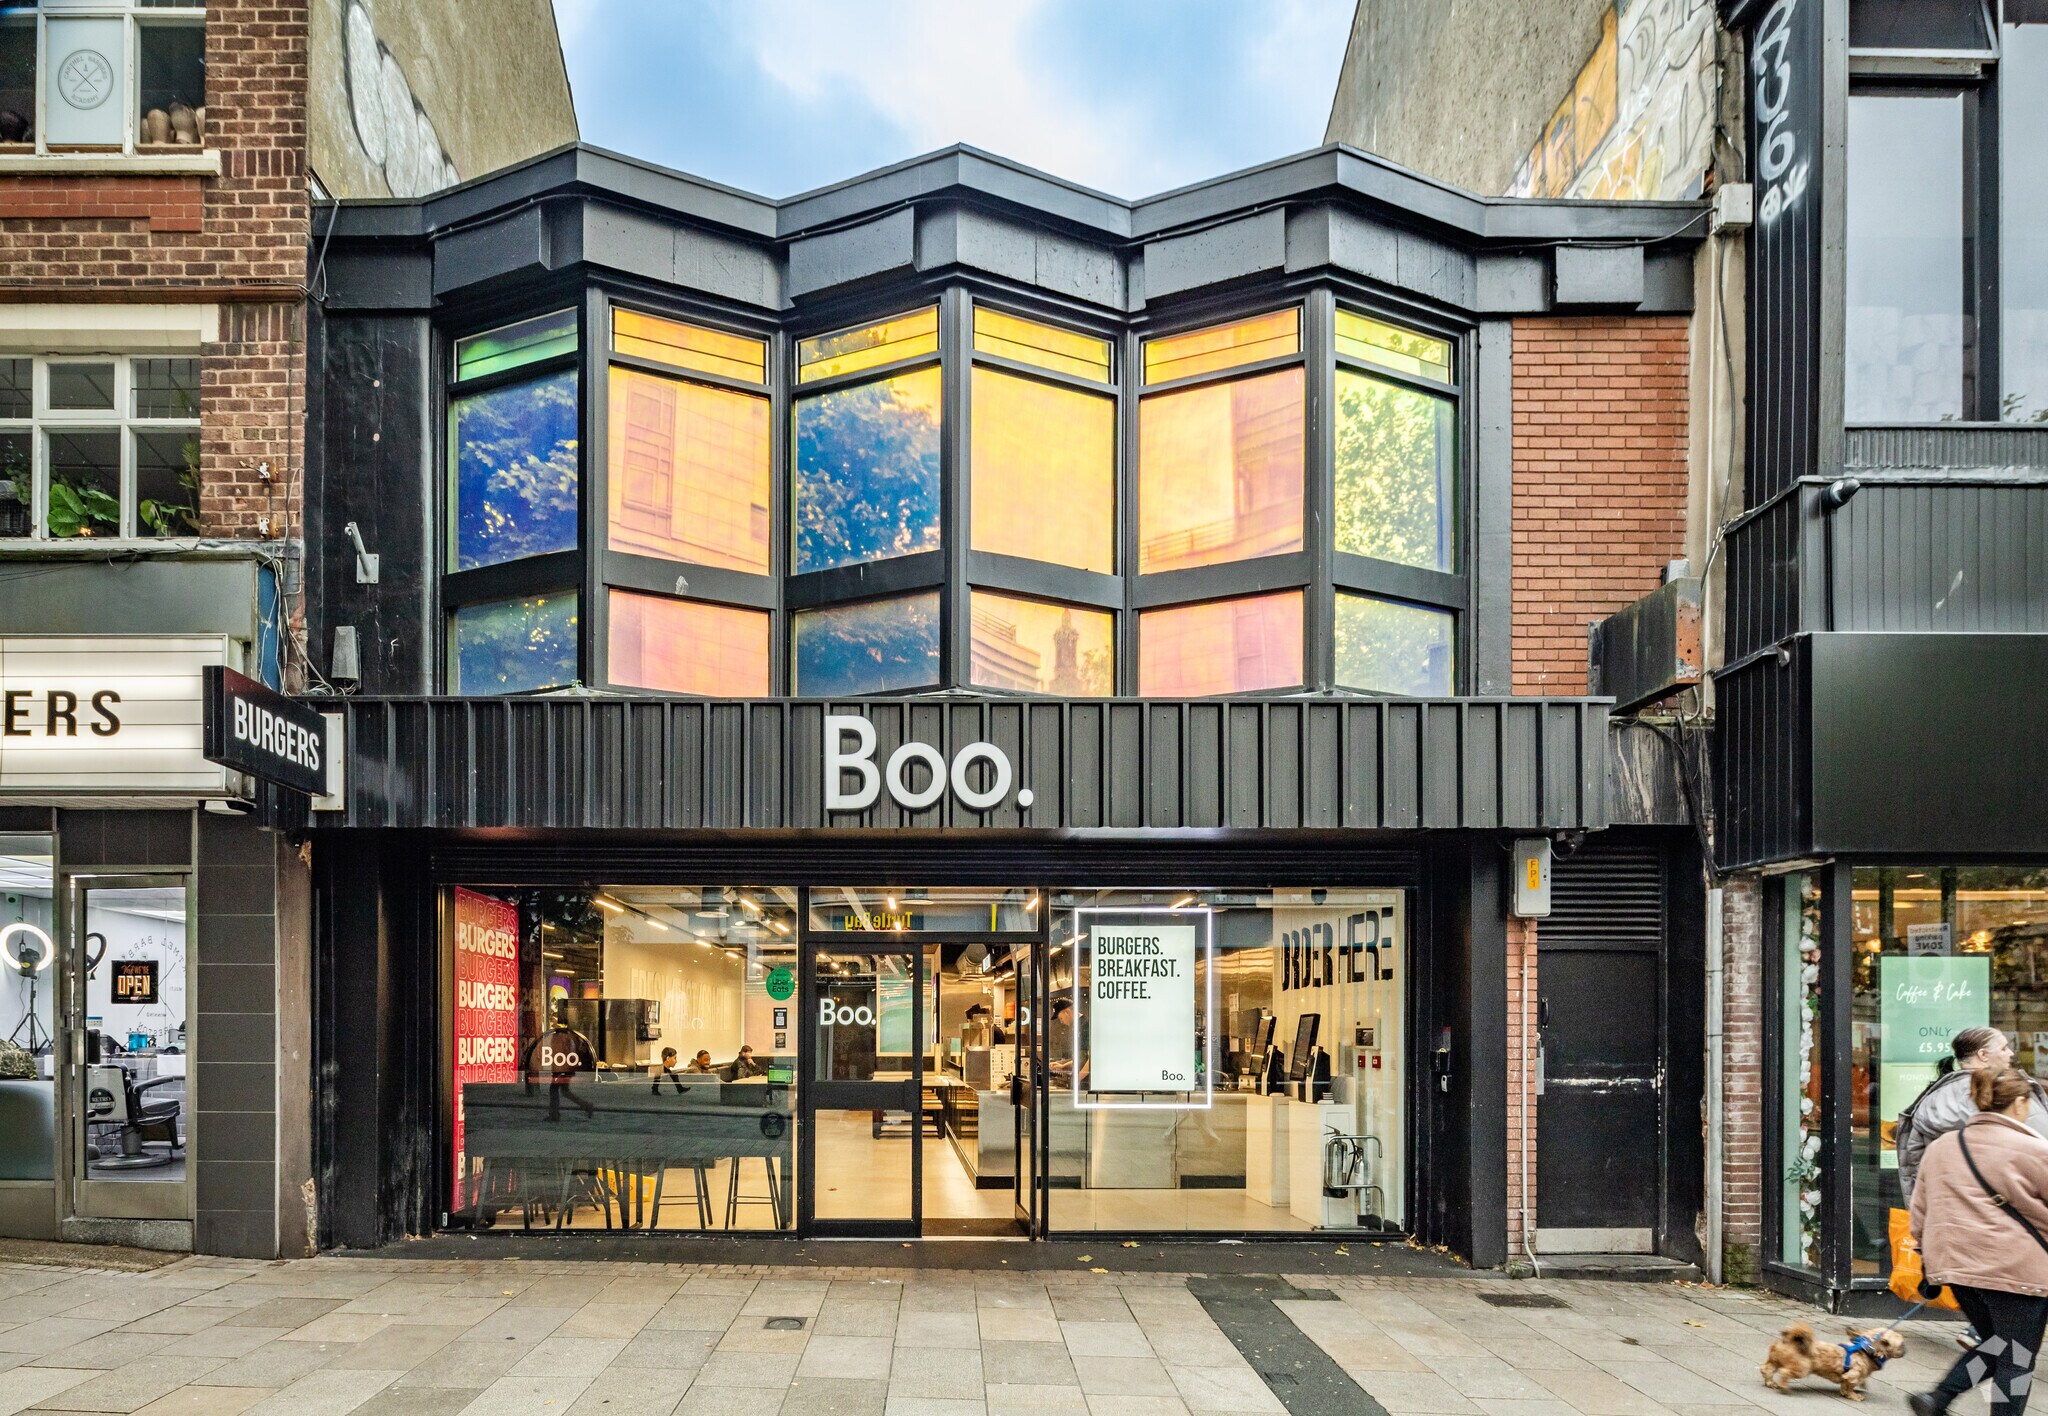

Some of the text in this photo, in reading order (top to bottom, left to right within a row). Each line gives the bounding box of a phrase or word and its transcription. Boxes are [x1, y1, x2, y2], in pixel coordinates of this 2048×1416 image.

[234, 696, 320, 771] BURGERS
[825, 715, 1034, 811] Boo.
[459, 894, 516, 935] BURGERS
[458, 922, 516, 960] BURGERS
[1097, 937, 1164, 956] BURGERS.
[1280, 906, 1394, 992] ORDER HERE
[458, 951, 516, 986] BURGERS
[1097, 959, 1181, 977] BREAKFAST.
[117, 975, 151, 996] OPEN
[458, 980, 516, 1011] BURGERS
[772, 985, 789, 993] Eats
[1097, 981, 1151, 999] COFFEE.
[1896, 980, 1972, 1004] Coffee & Cake
[458, 1008, 516, 1037] BURGERS
[820, 997, 876, 1025] Boo.
[1919, 1027, 1952, 1037] ONLY
[458, 1036, 515, 1065] BURGERS
[541, 1046, 583, 1067] Boo.
[1919, 1042, 1951, 1053] £5.95
[1162, 1069, 1186, 1081] Boo.
